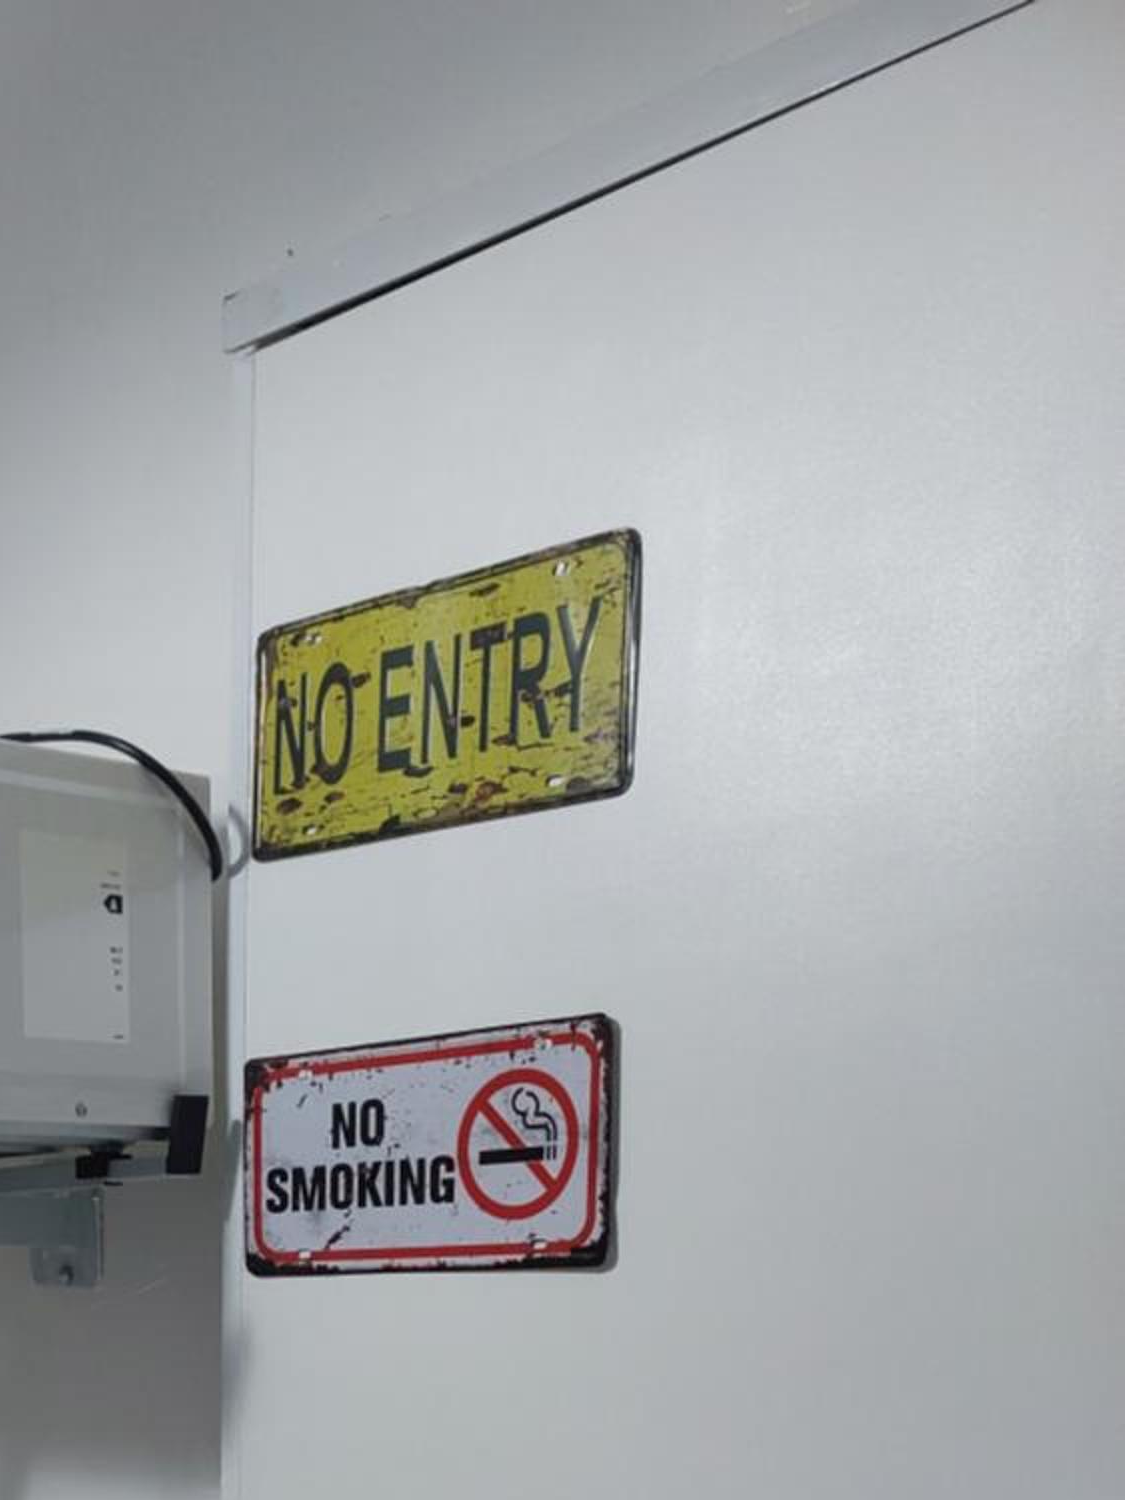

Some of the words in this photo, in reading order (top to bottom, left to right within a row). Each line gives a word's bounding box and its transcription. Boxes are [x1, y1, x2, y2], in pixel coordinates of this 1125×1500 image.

[274, 662, 355, 796] NO
[376, 595, 602, 774] ENTRY
[331, 1098, 386, 1150] NO
[266, 1155, 455, 1214] SMOKING
